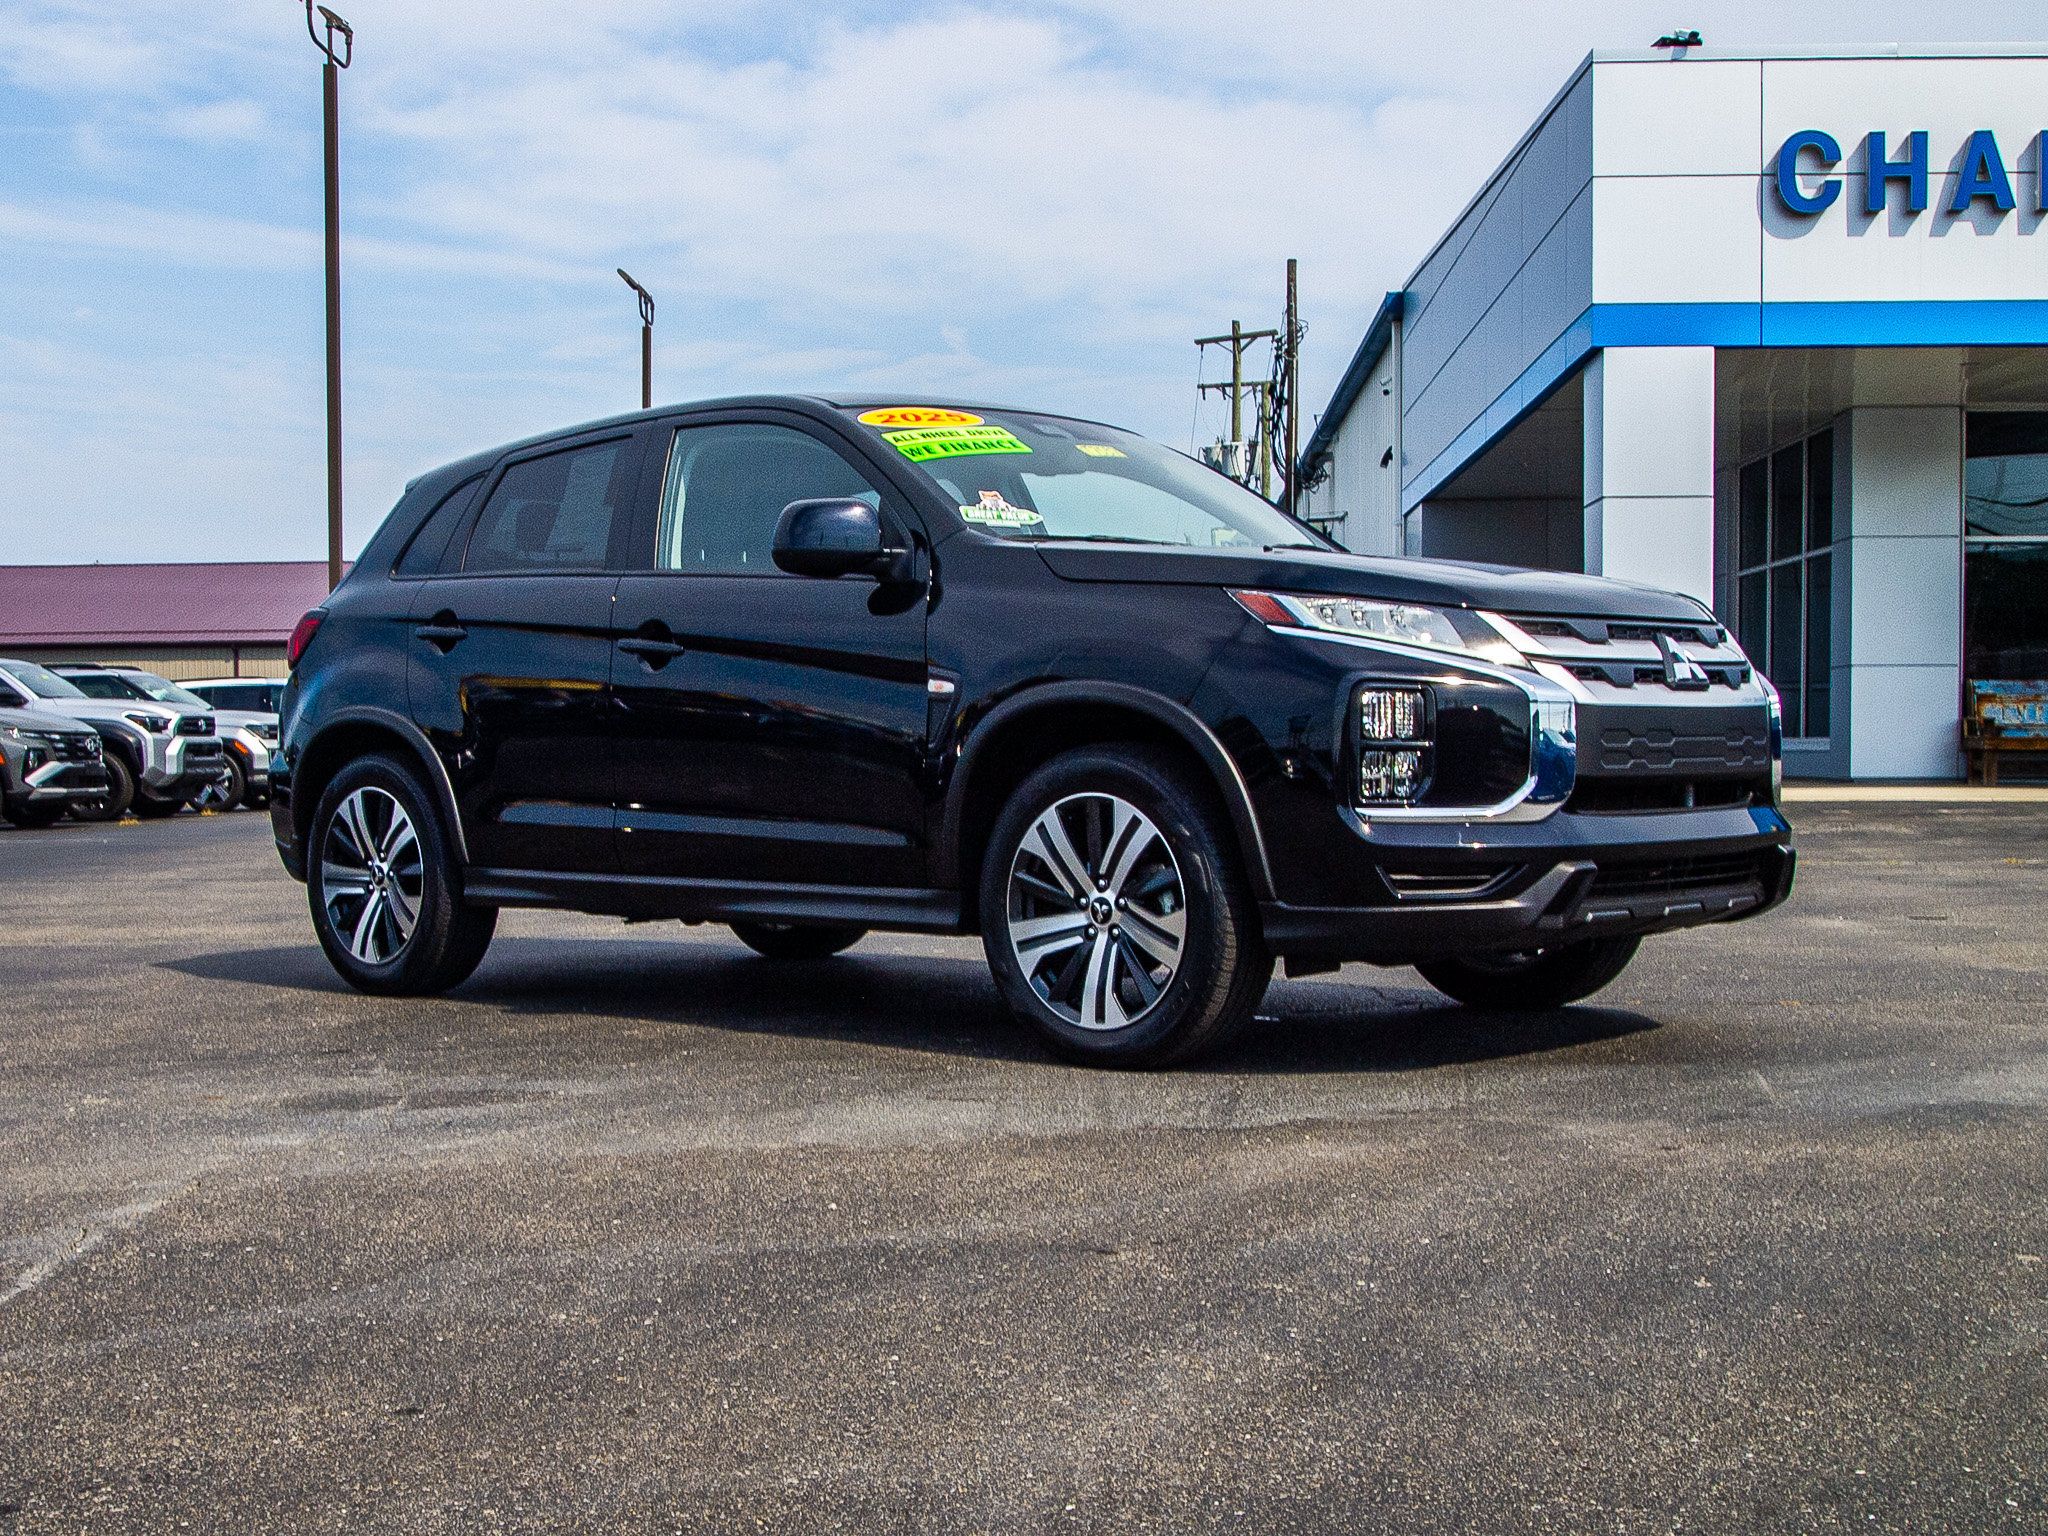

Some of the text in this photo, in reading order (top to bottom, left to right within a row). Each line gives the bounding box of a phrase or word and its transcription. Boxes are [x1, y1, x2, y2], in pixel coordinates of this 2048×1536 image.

[1777, 129, 2048, 214] CHA
[877, 412, 967, 424] 2025
[892, 428, 1007, 443] ALL WHEEL DRIVE
[904, 439, 1021, 458] WE FINANCE
